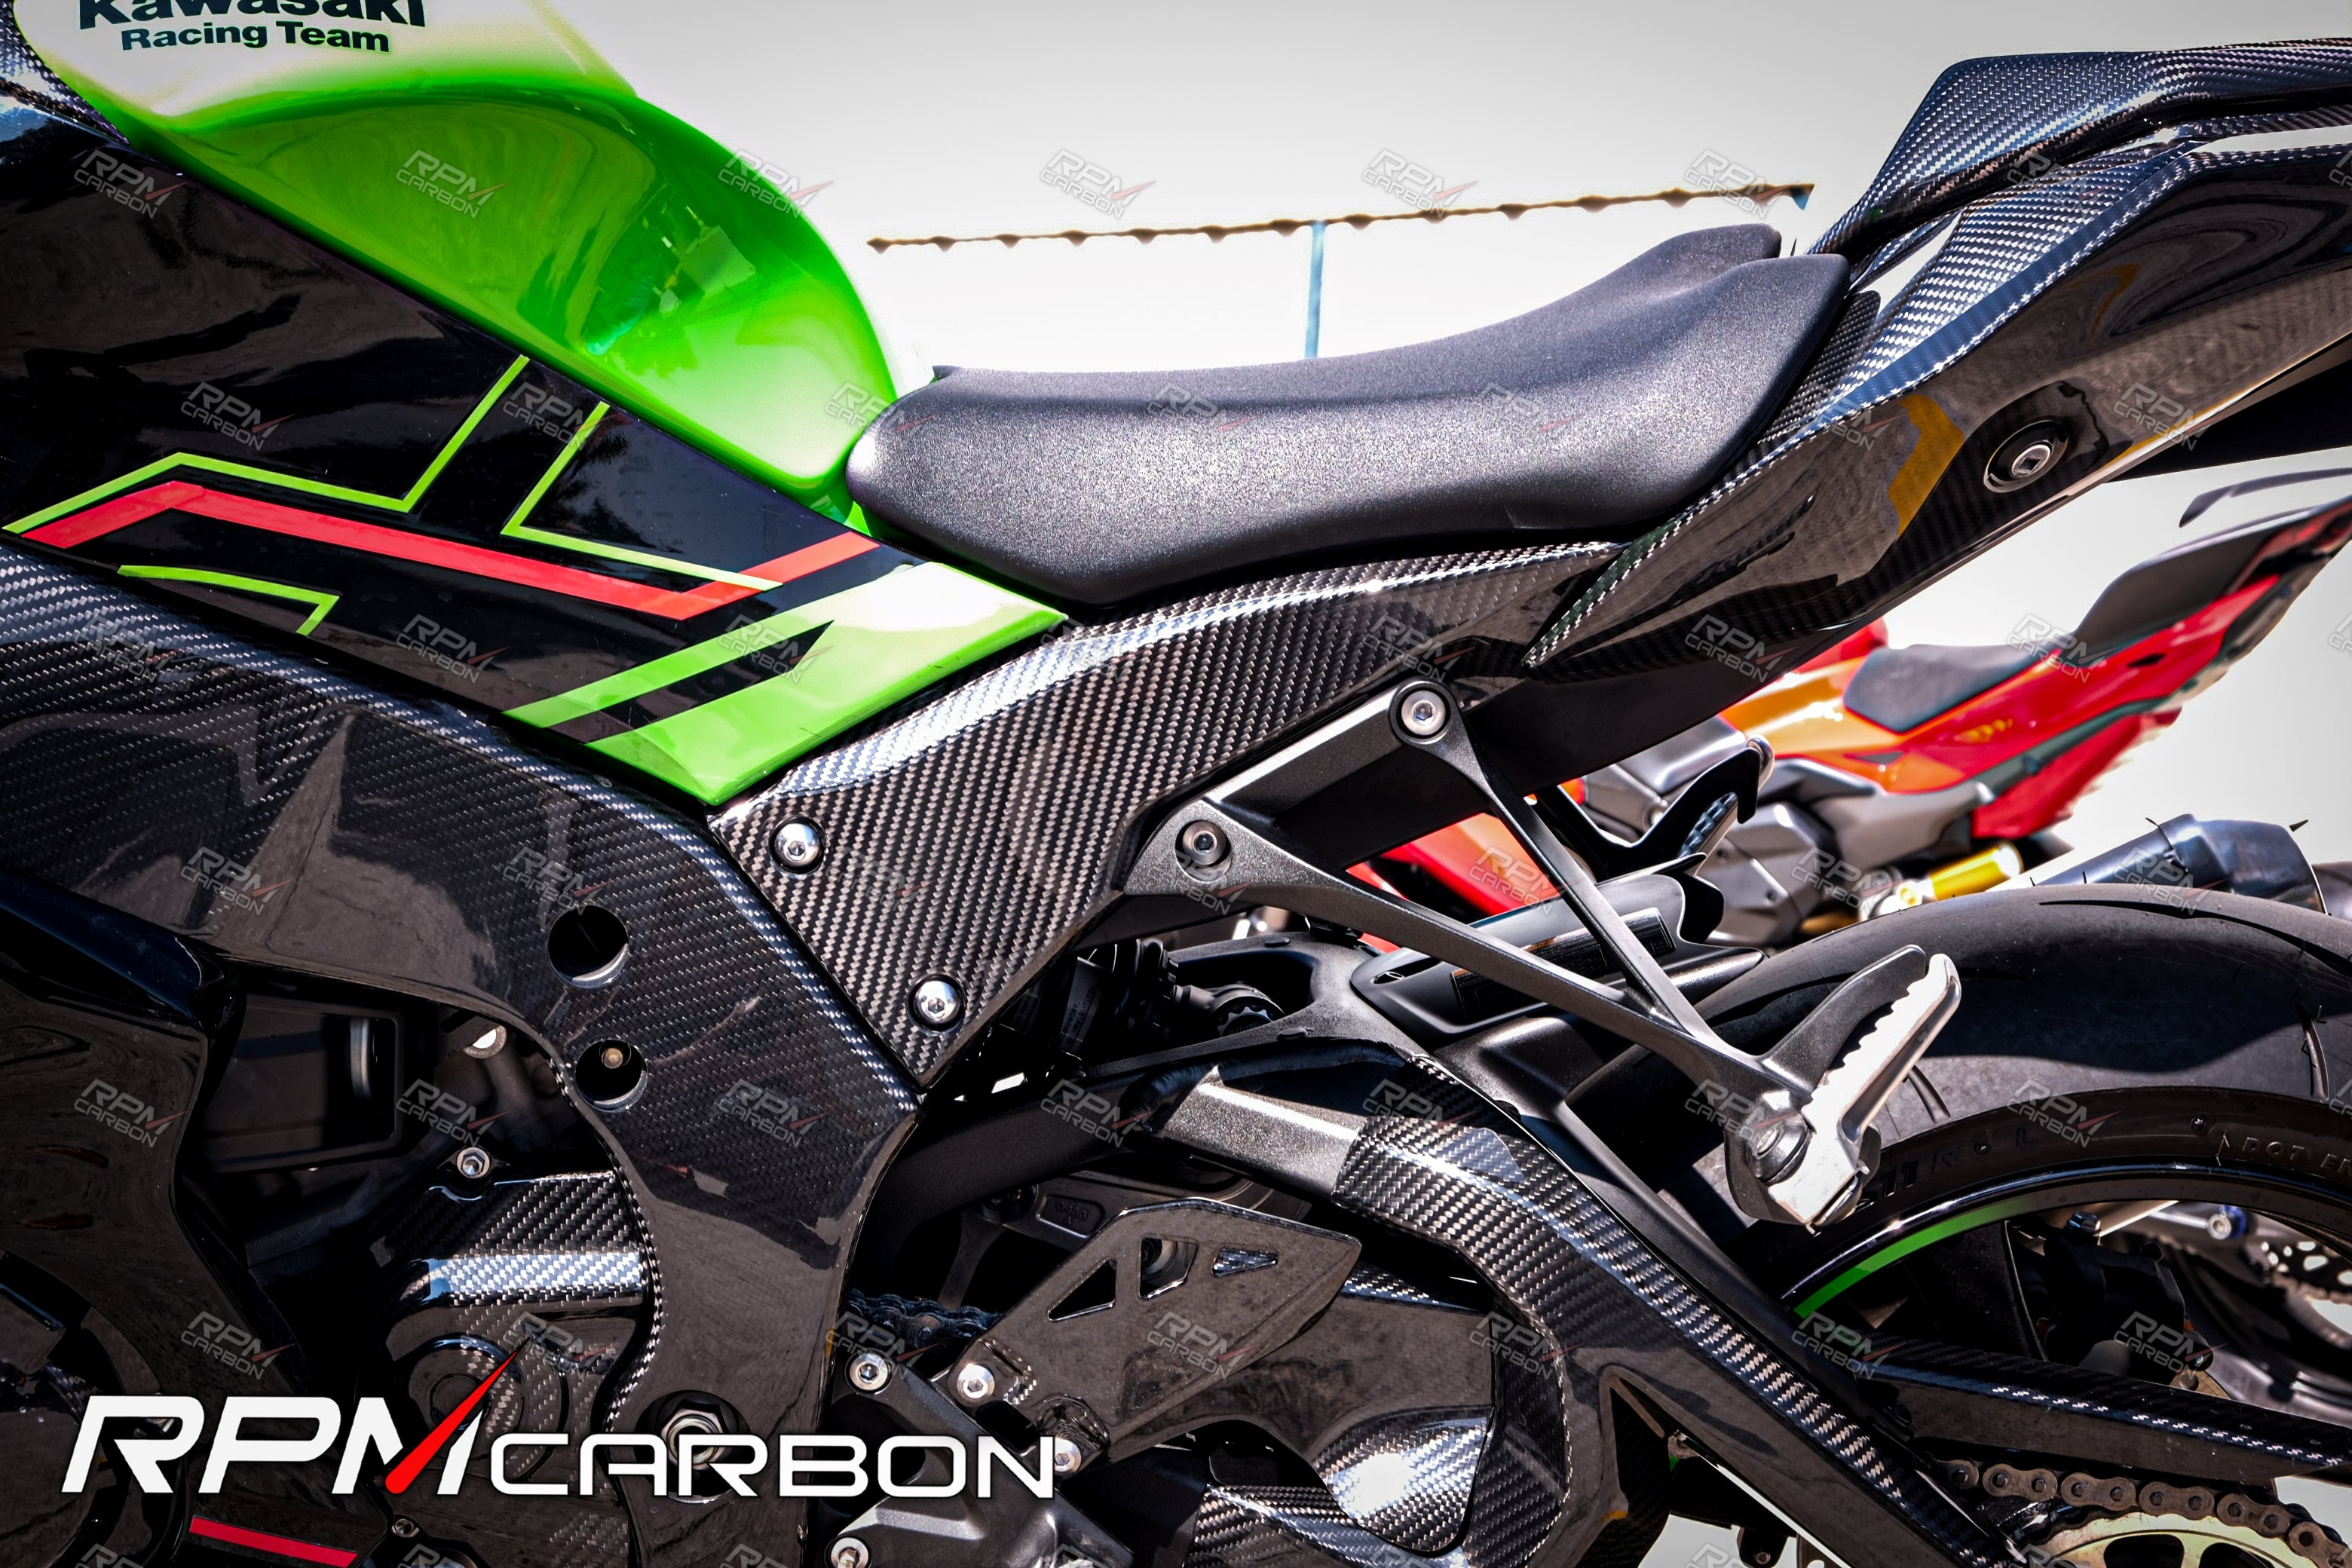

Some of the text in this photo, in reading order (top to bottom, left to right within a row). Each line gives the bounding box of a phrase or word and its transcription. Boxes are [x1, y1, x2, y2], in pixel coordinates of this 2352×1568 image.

[121, 20, 389, 52] Racing Team
[2241, 1136, 2305, 1161] DOT
